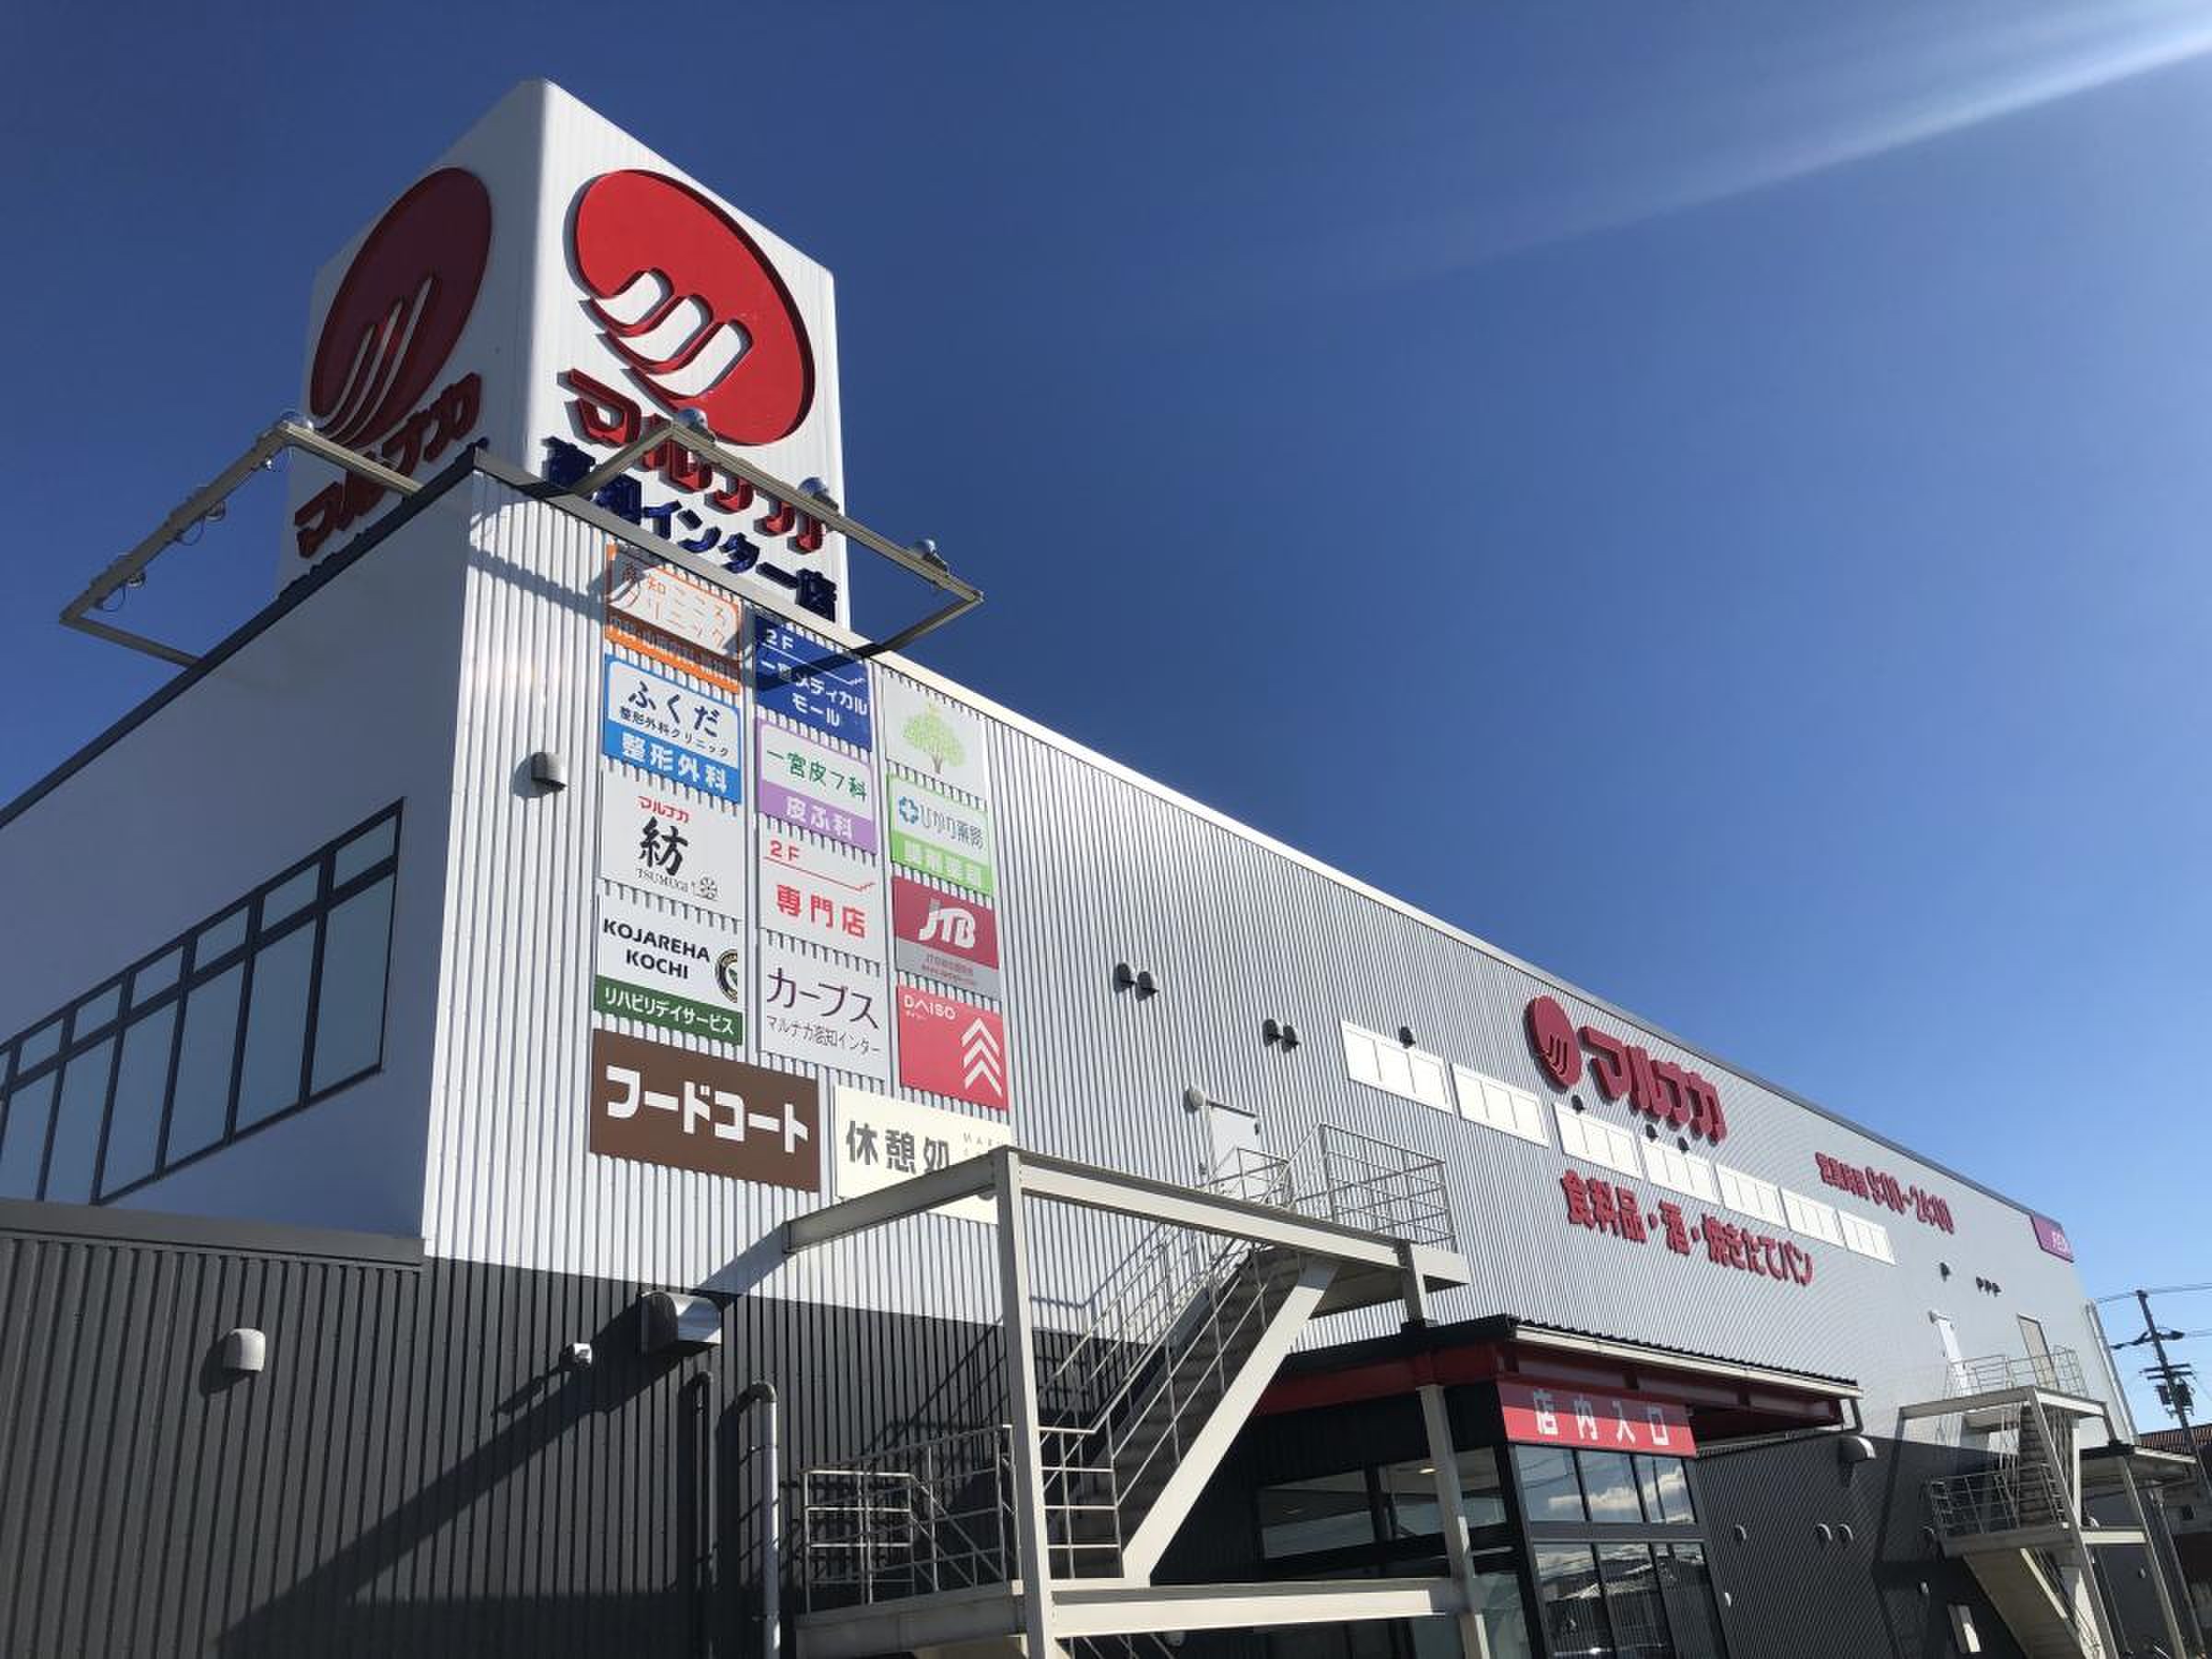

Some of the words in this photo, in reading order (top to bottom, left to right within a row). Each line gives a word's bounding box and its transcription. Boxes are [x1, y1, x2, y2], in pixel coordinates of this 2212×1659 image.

[766, 629, 794, 650] 2F
[619, 705, 729, 757] 整形外科クリニック
[628, 680, 721, 737] ふくだ
[792, 692, 841, 727] モール
[621, 732, 728, 794] 整形外科
[638, 794, 689, 824] マルナカ
[786, 795, 853, 841] 皮ふ科
[639, 816, 689, 876] 紡
[771, 840, 800, 861] 2F
[776, 883, 865, 938] 専門店
[918, 898, 975, 948] JTB
[604, 918, 711, 963] KOJAREHA
[626, 949, 688, 980] KOCHI
[766, 967, 879, 1030] カーブス
[903, 994, 957, 1020] DAISO
[606, 1065, 809, 1154] フードコート
[1577, 1025, 1728, 1147] マルナカ
[845, 1119, 950, 1175] 休憩処
[1532, 1388, 1670, 1446] 店内入口
